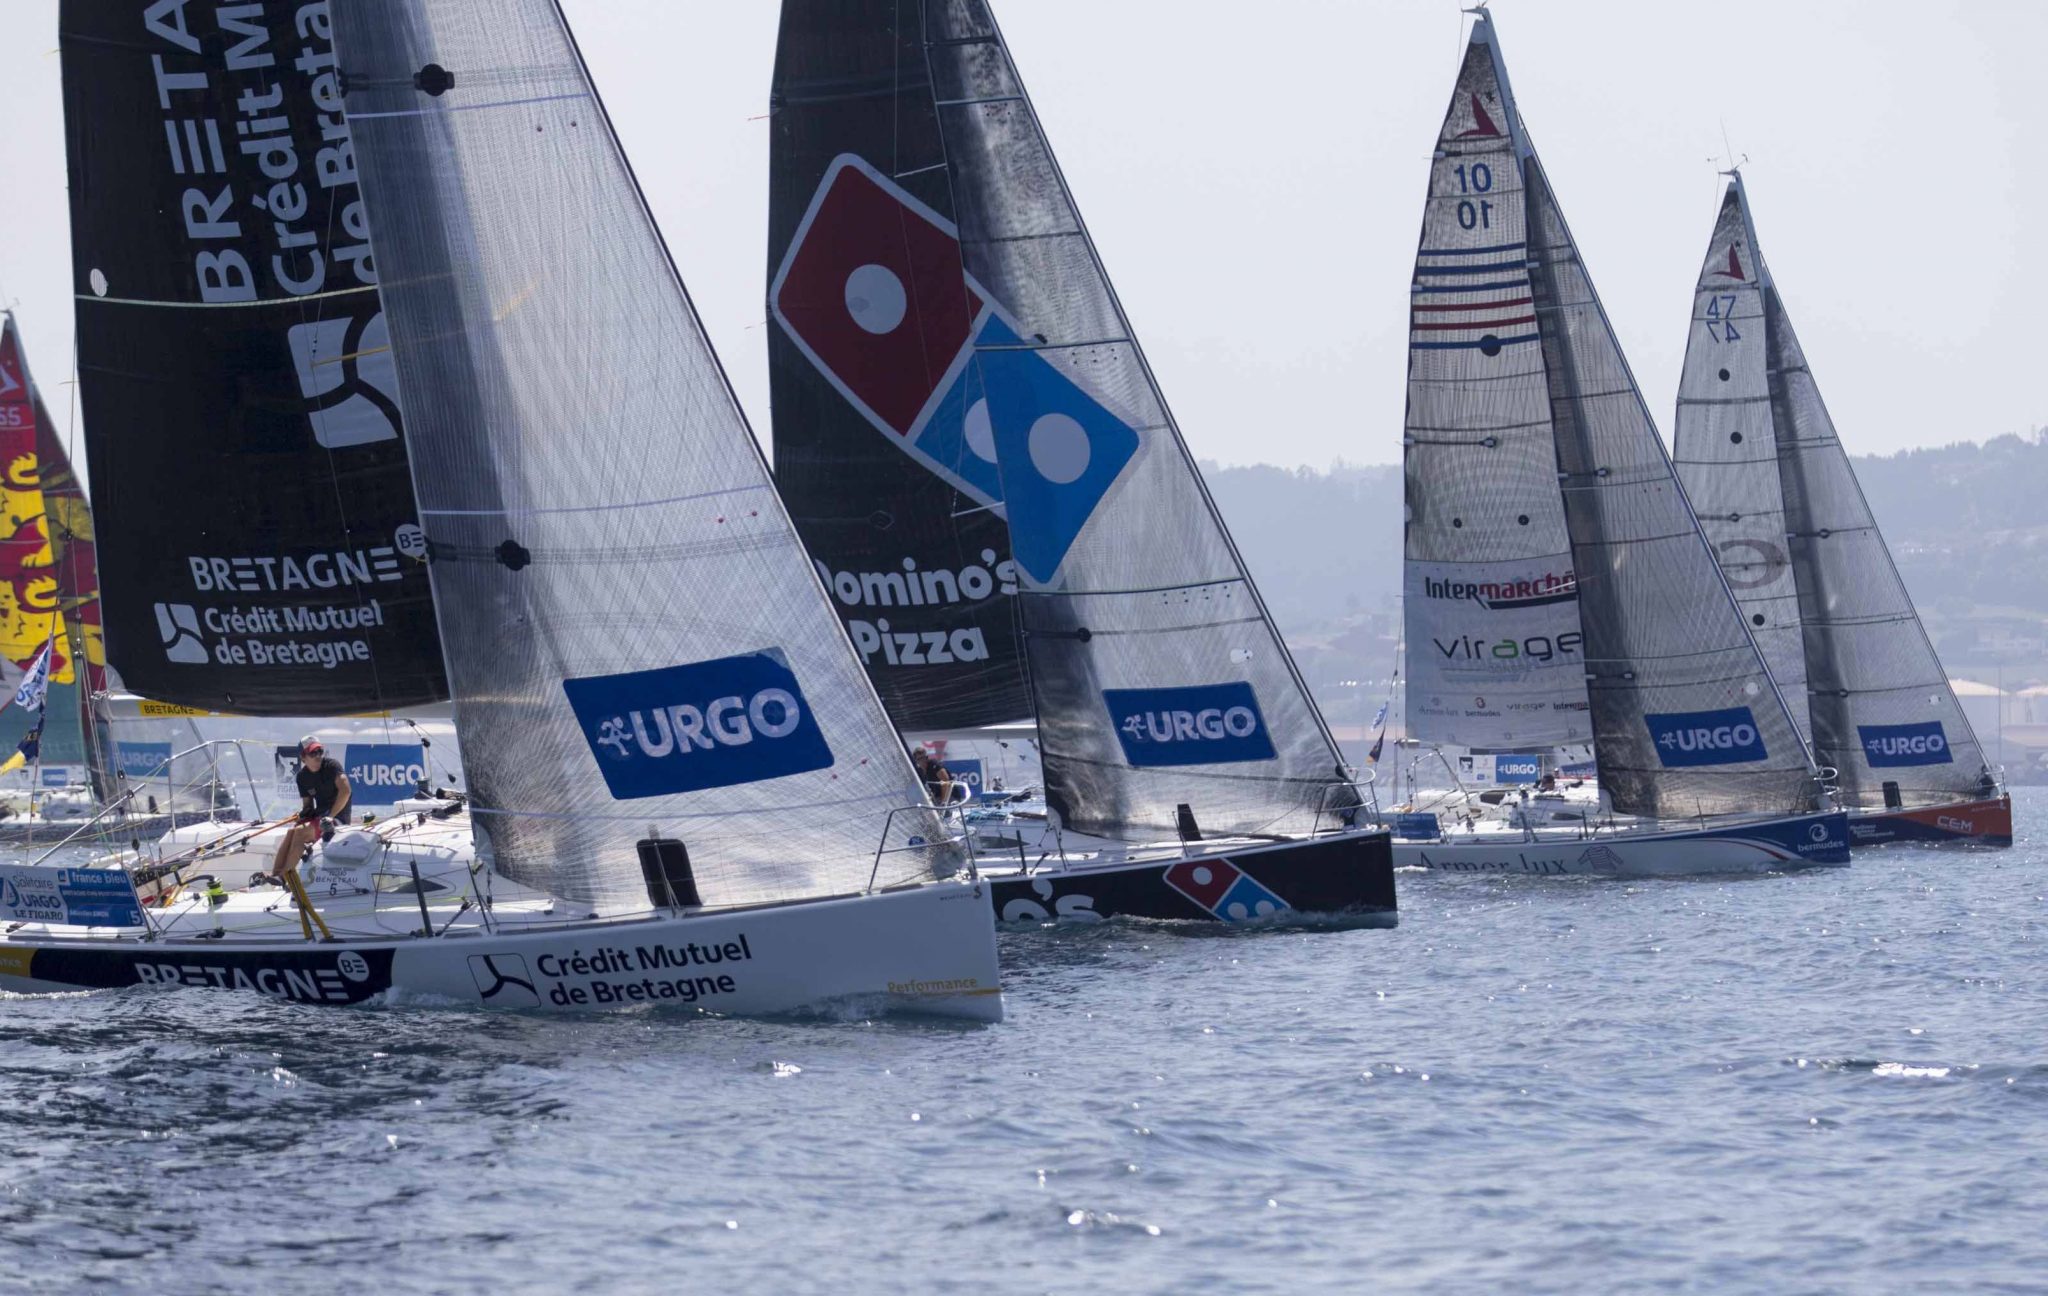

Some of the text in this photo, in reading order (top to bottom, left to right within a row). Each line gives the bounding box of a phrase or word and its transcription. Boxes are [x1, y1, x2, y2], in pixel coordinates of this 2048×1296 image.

[236, 82, 325, 295] Crédit
[1454, 163, 1492, 194] 10
[1706, 295, 1737, 319] 47
[188, 546, 403, 591] BRETAGNE
[204, 599, 384, 633] Crédit Mutuel
[215, 637, 370, 669] de Bretagne
[849, 618, 990, 665] Pizza
[1433, 632, 1582, 662] virage
[144, 704, 194, 715] BRETAGNE
[629, 687, 801, 758] URGO
[1145, 706, 1257, 742] URGO
[1675, 724, 1756, 752] URGO
[1880, 734, 1944, 756] URGO
[121, 751, 165, 767] URGO
[1503, 763, 1537, 775] URGO
[363, 764, 424, 786] URGO
[951, 771, 980, 786] RGO
[1797, 841, 1845, 852] bermudes
[13, 875, 54, 889] Solitaire
[72, 871, 102, 884] france
[104, 871, 127, 884] bleu
[330, 883, 337, 896] 5
[21, 895, 61, 909] URGO
[14, 909, 29, 919] LE
[30, 910, 64, 921] FIGARO
[129, 910, 140, 924] 5
[536, 934, 752, 977] Crédit Mutuel
[134, 962, 350, 1000] BRETAGNE
[549, 974, 737, 1006] de Bretagne
[887, 977, 977, 994] Performance
